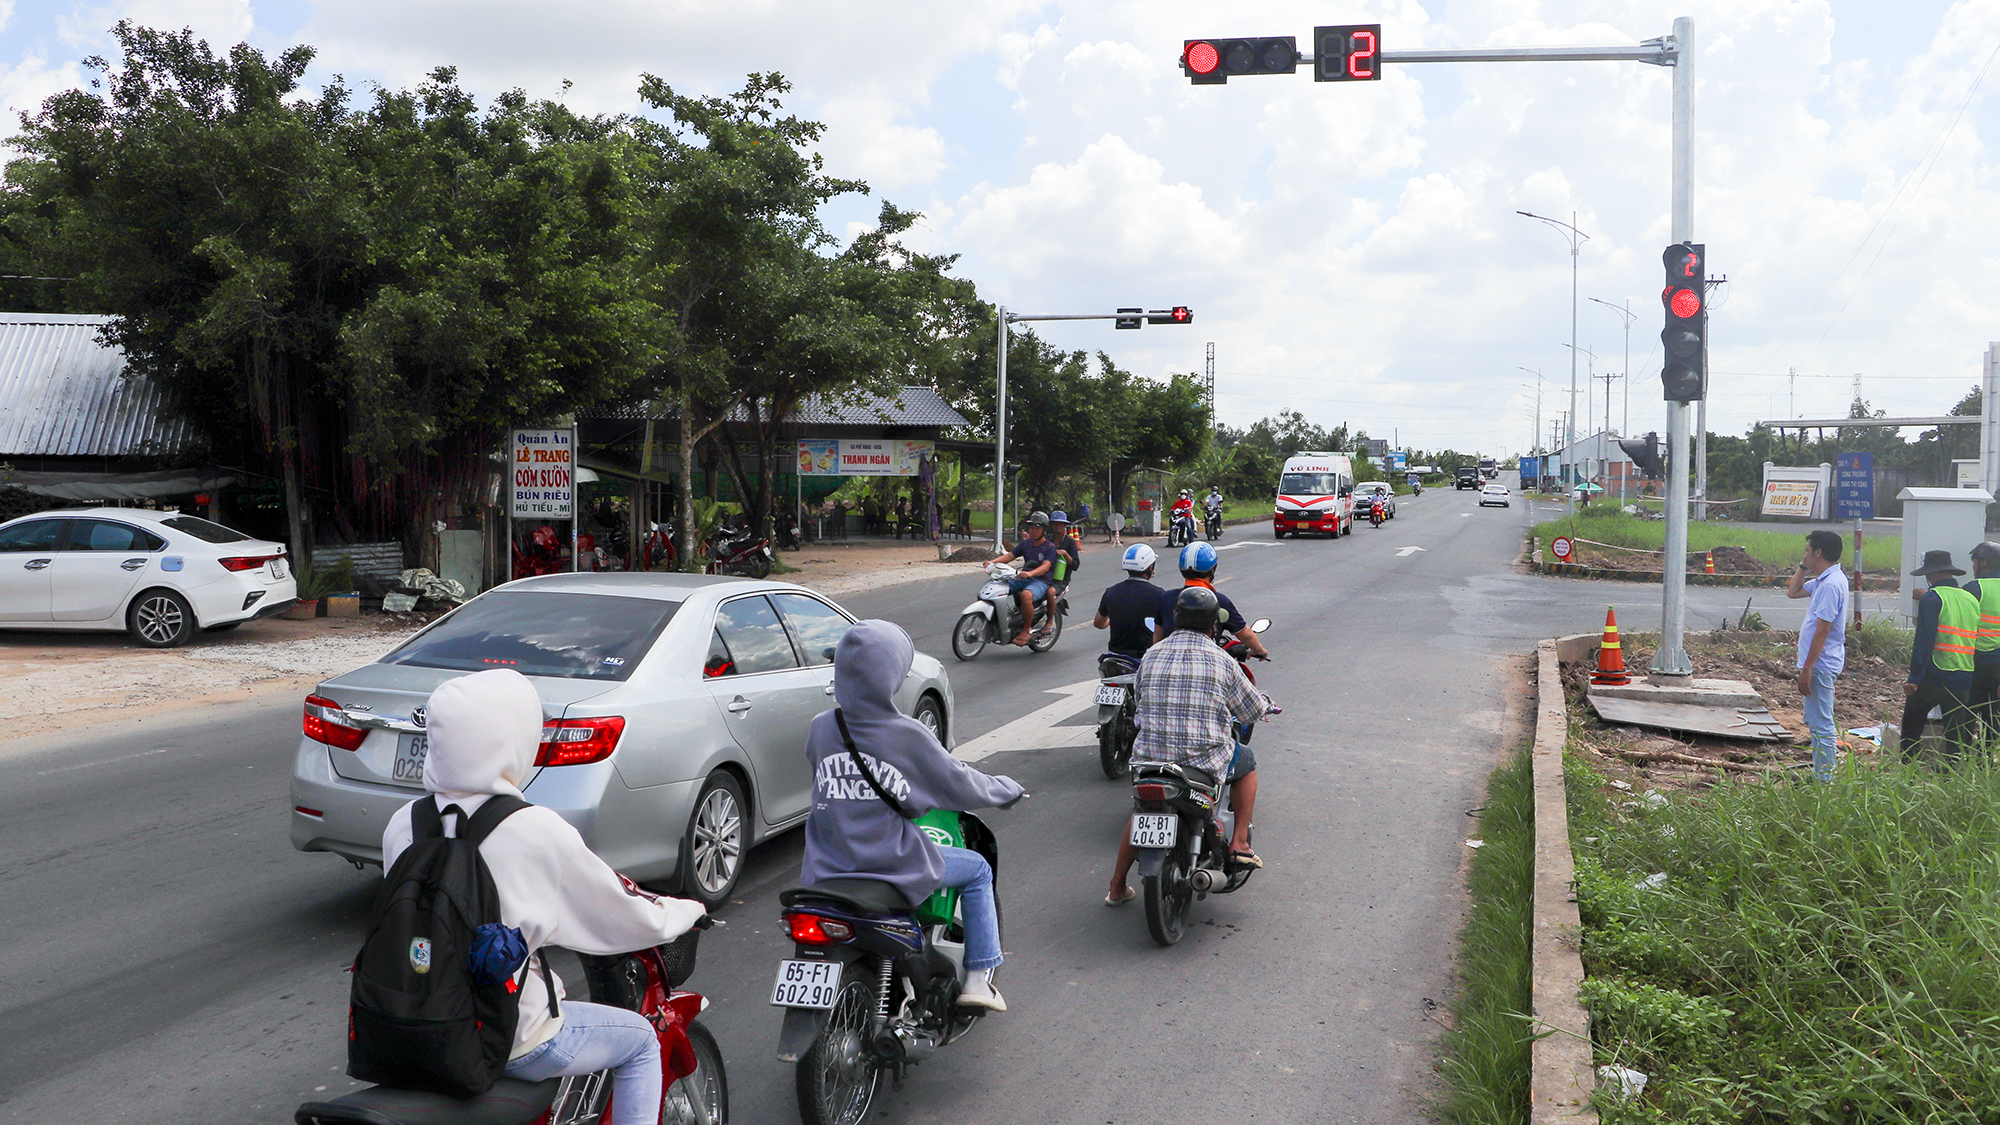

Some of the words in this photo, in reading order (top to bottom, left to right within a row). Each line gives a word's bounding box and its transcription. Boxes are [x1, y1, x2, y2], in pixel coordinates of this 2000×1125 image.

[1349, 31, 1375, 77] 2
[1684, 253, 1697, 276] 2
[518, 433, 547, 446] Quán
[552, 432, 568, 444] Ăn
[516, 446, 530, 462] LÊ
[533, 450, 570, 463] TRANG
[842, 455, 867, 464] THANH
[870, 453, 890, 464] NGÂN
[516, 466, 538, 487] CƠM
[541, 465, 570, 487] SƯỜN
[516, 490, 540, 500] BÚN
[544, 490, 570, 500] RIÊU
[786, 963, 830, 983] 65-F1
[776, 984, 833, 1006] 602.90
